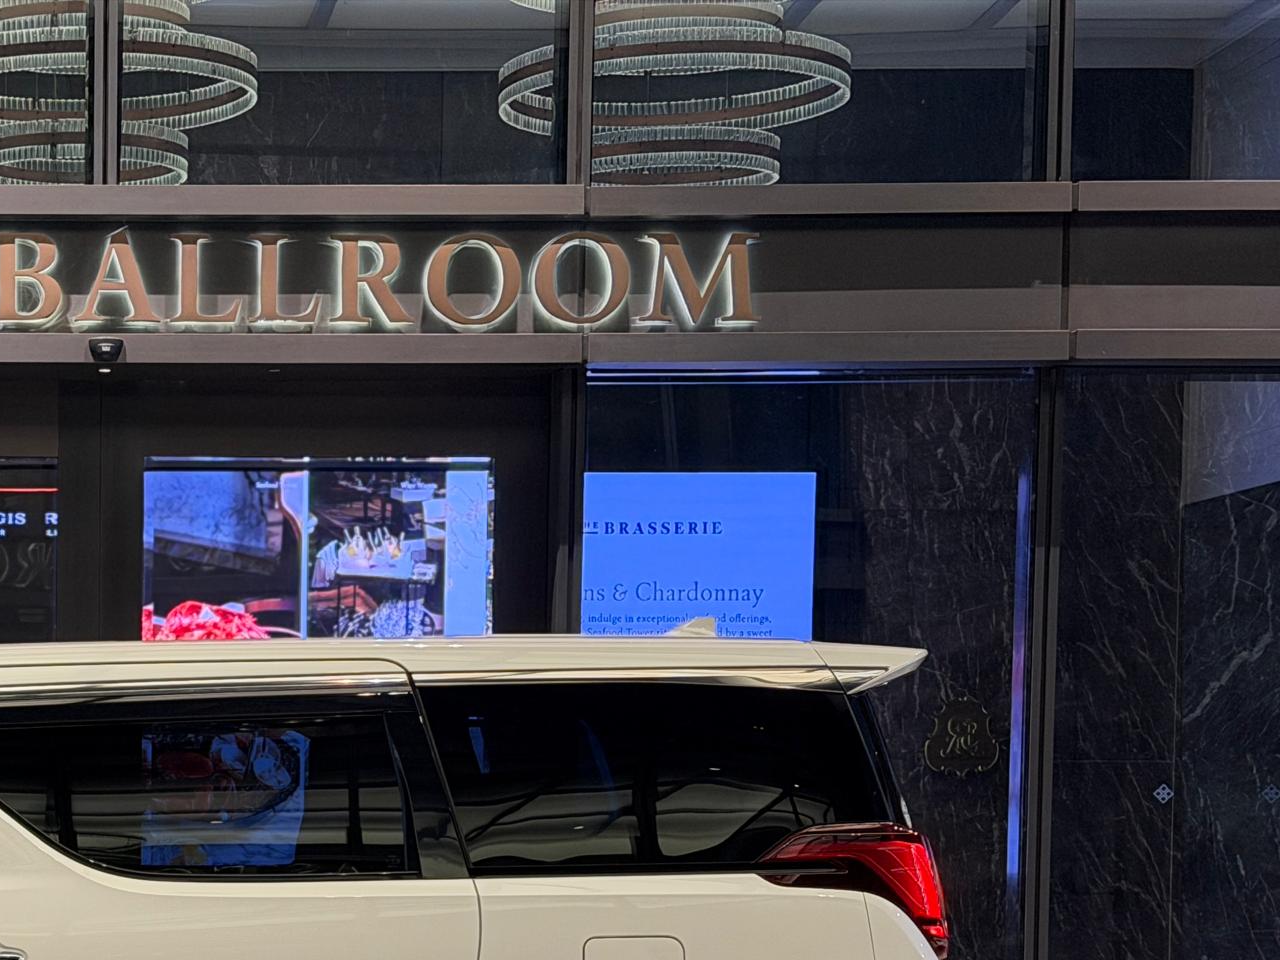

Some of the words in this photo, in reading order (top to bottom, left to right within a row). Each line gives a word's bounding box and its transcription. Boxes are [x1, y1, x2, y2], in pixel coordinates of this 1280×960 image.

[604, 521, 723, 535] BRASSERIE
[612, 583, 628, 602] &
[635, 581, 764, 608] Chardonnay
[588, 613, 621, 625] indulge
[625, 613, 634, 623] in
[636, 613, 688, 625] exceptional
